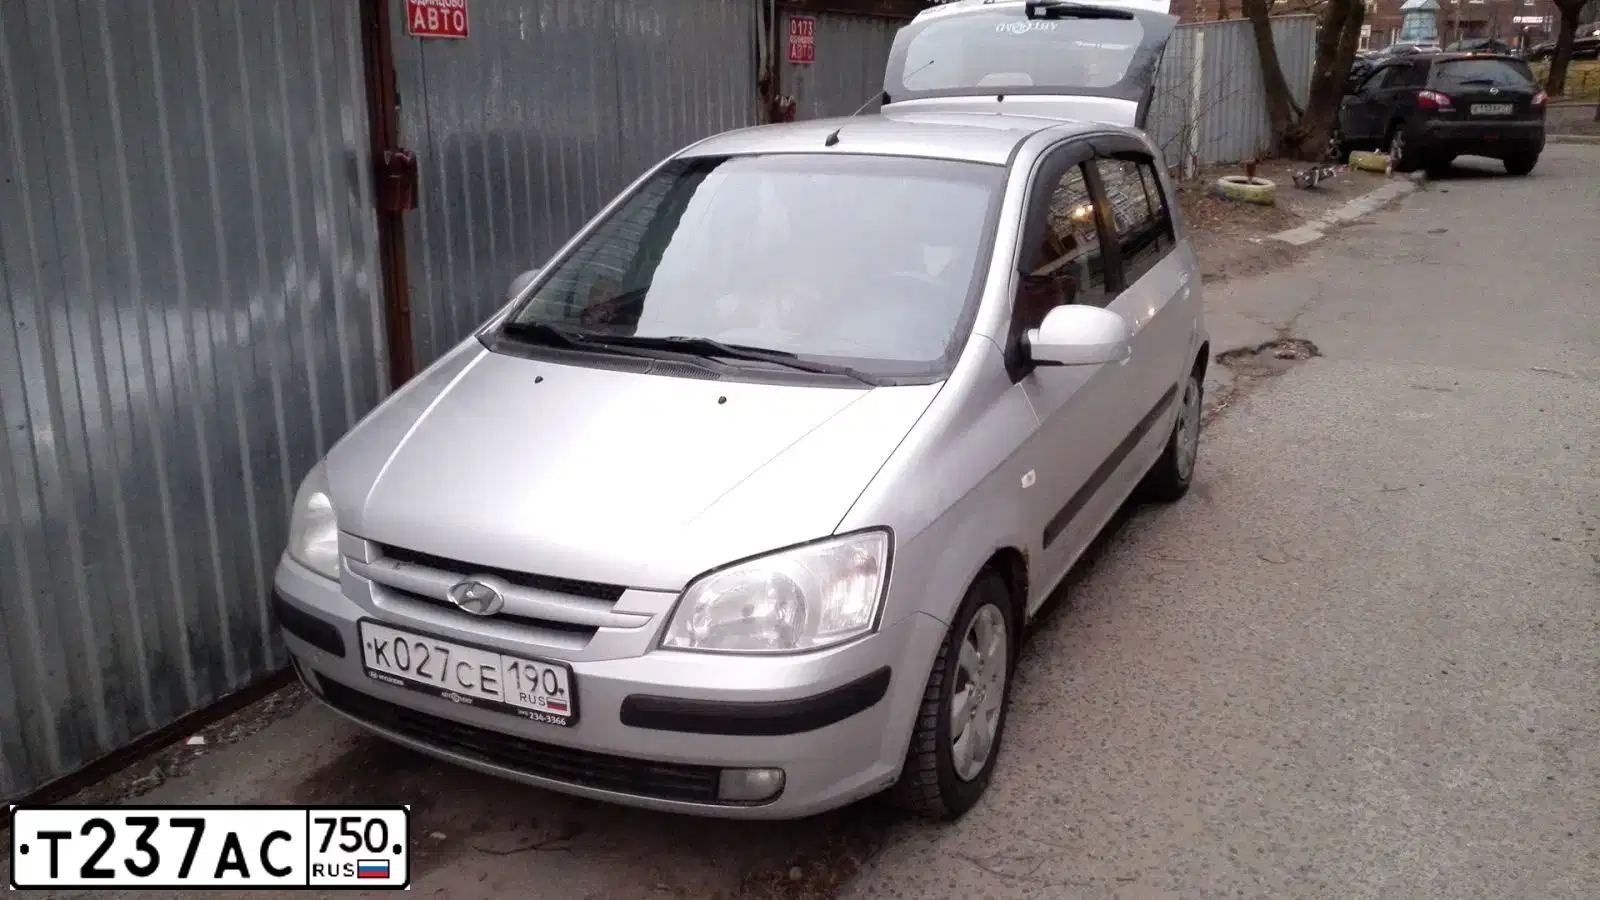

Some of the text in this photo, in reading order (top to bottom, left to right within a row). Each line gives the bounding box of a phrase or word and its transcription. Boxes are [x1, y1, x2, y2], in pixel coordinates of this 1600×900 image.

[414, 7, 464, 32] АВТО
[791, 44, 813, 60] АВТО
[373, 636, 559, 696] К027СЕ 190
[519, 692, 546, 706] RUS
[529, 711, 567, 727] 234-3366
